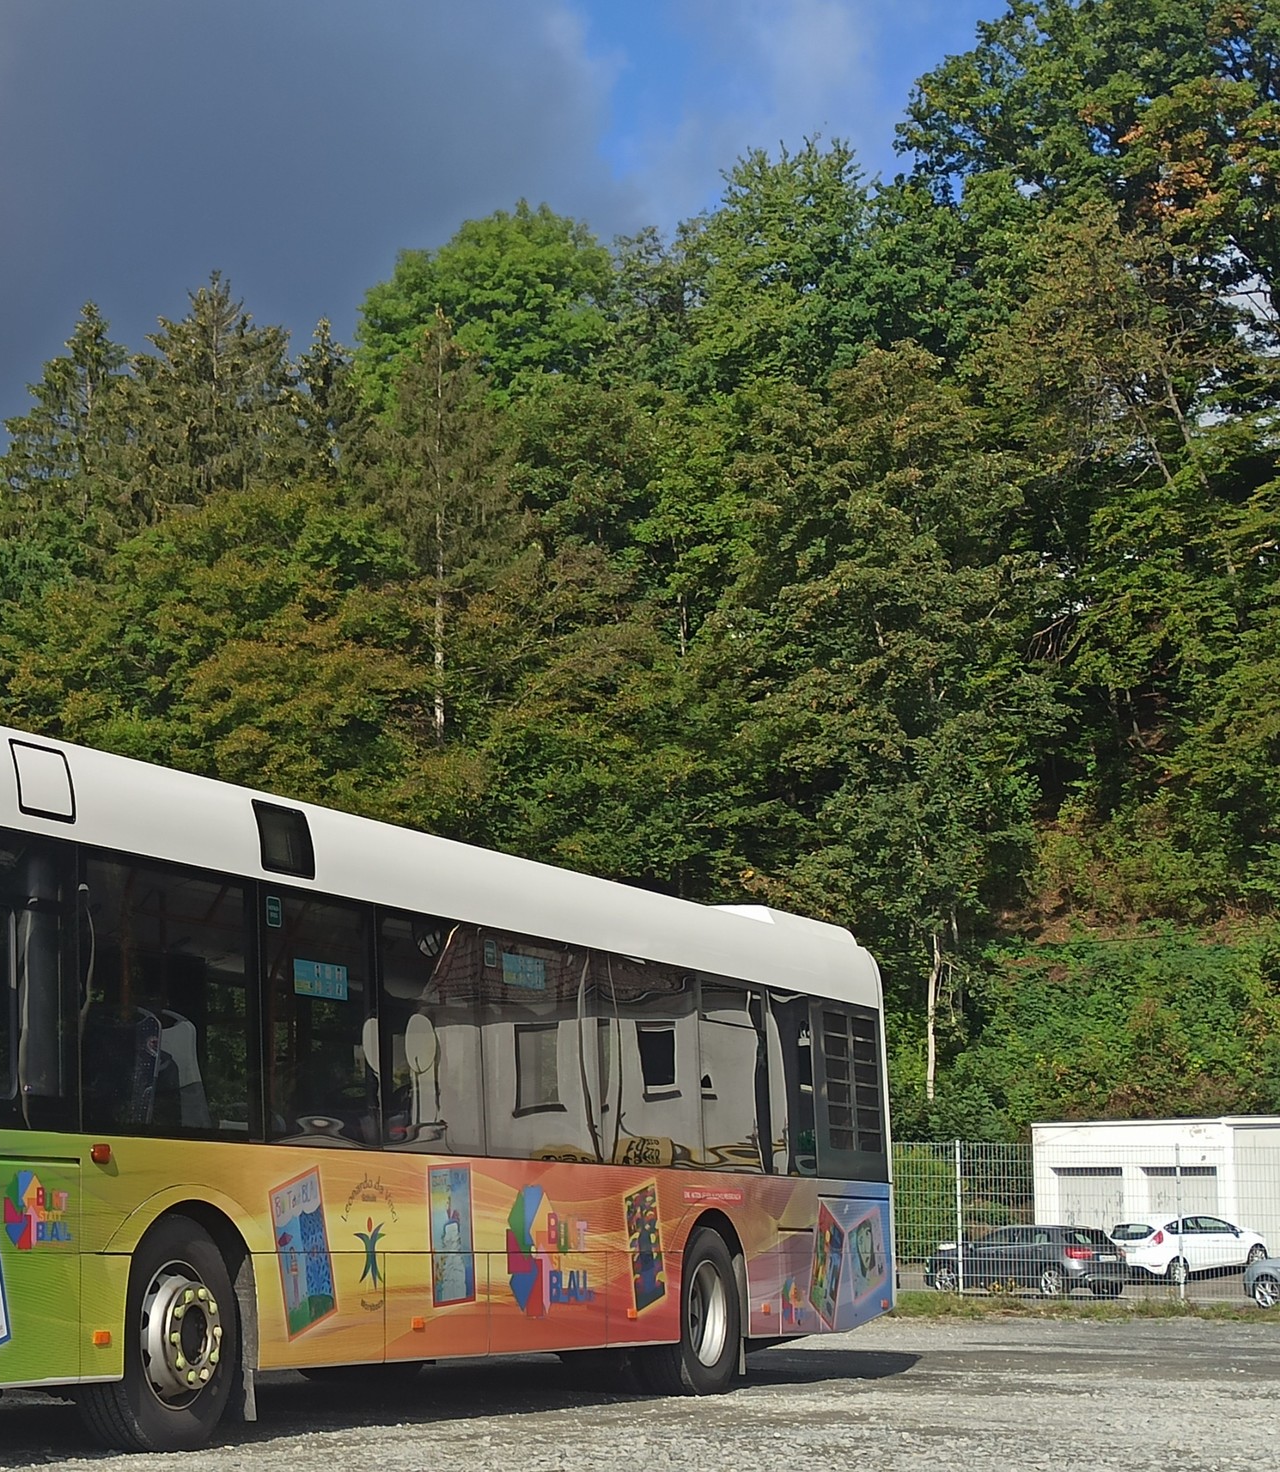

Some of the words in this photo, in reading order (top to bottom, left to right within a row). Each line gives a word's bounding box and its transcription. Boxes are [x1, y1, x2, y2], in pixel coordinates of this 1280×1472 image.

[37, 1187, 68, 1212] BUNT
[40, 1211, 62, 1222] STATT
[550, 1270, 587, 1302] BLAU
